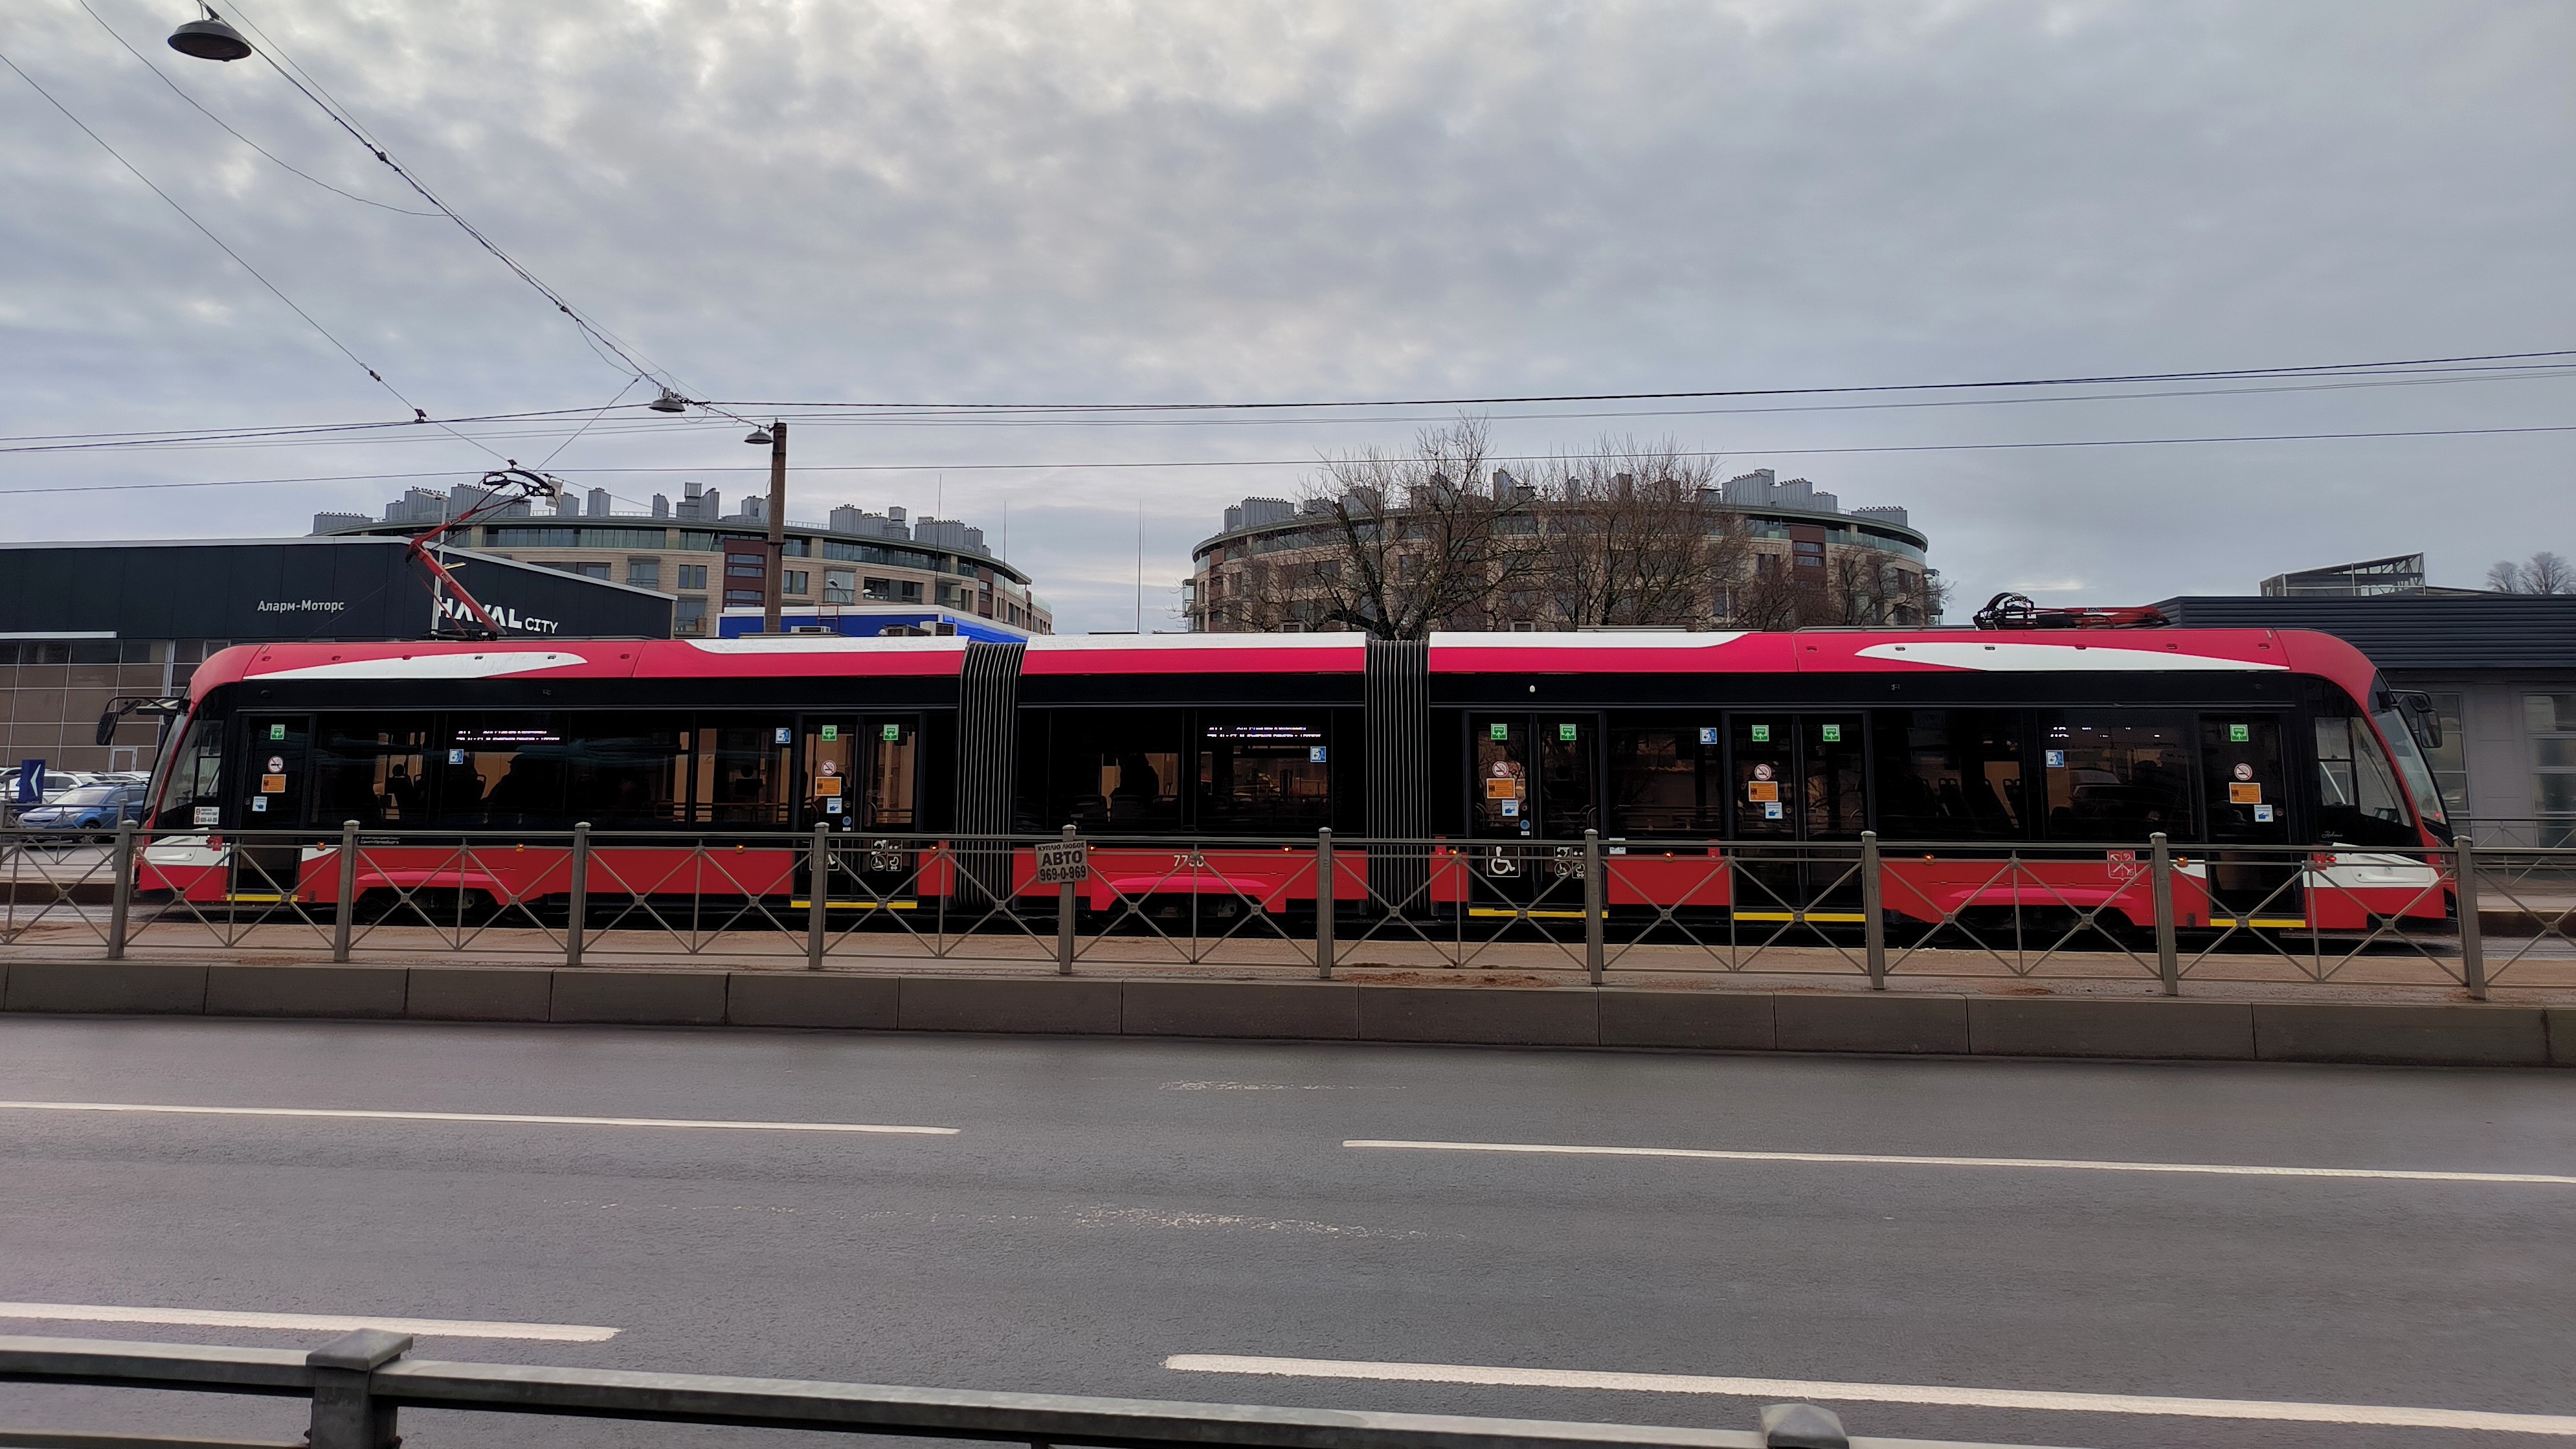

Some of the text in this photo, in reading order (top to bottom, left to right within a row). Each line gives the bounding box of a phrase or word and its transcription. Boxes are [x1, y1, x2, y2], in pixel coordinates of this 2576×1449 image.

[257, 600, 345, 613] Аларм-Моторс
[525, 617, 558, 634] CITY
[1042, 850, 1083, 867] АВТО
[1040, 865, 1086, 881] 969-0-969
